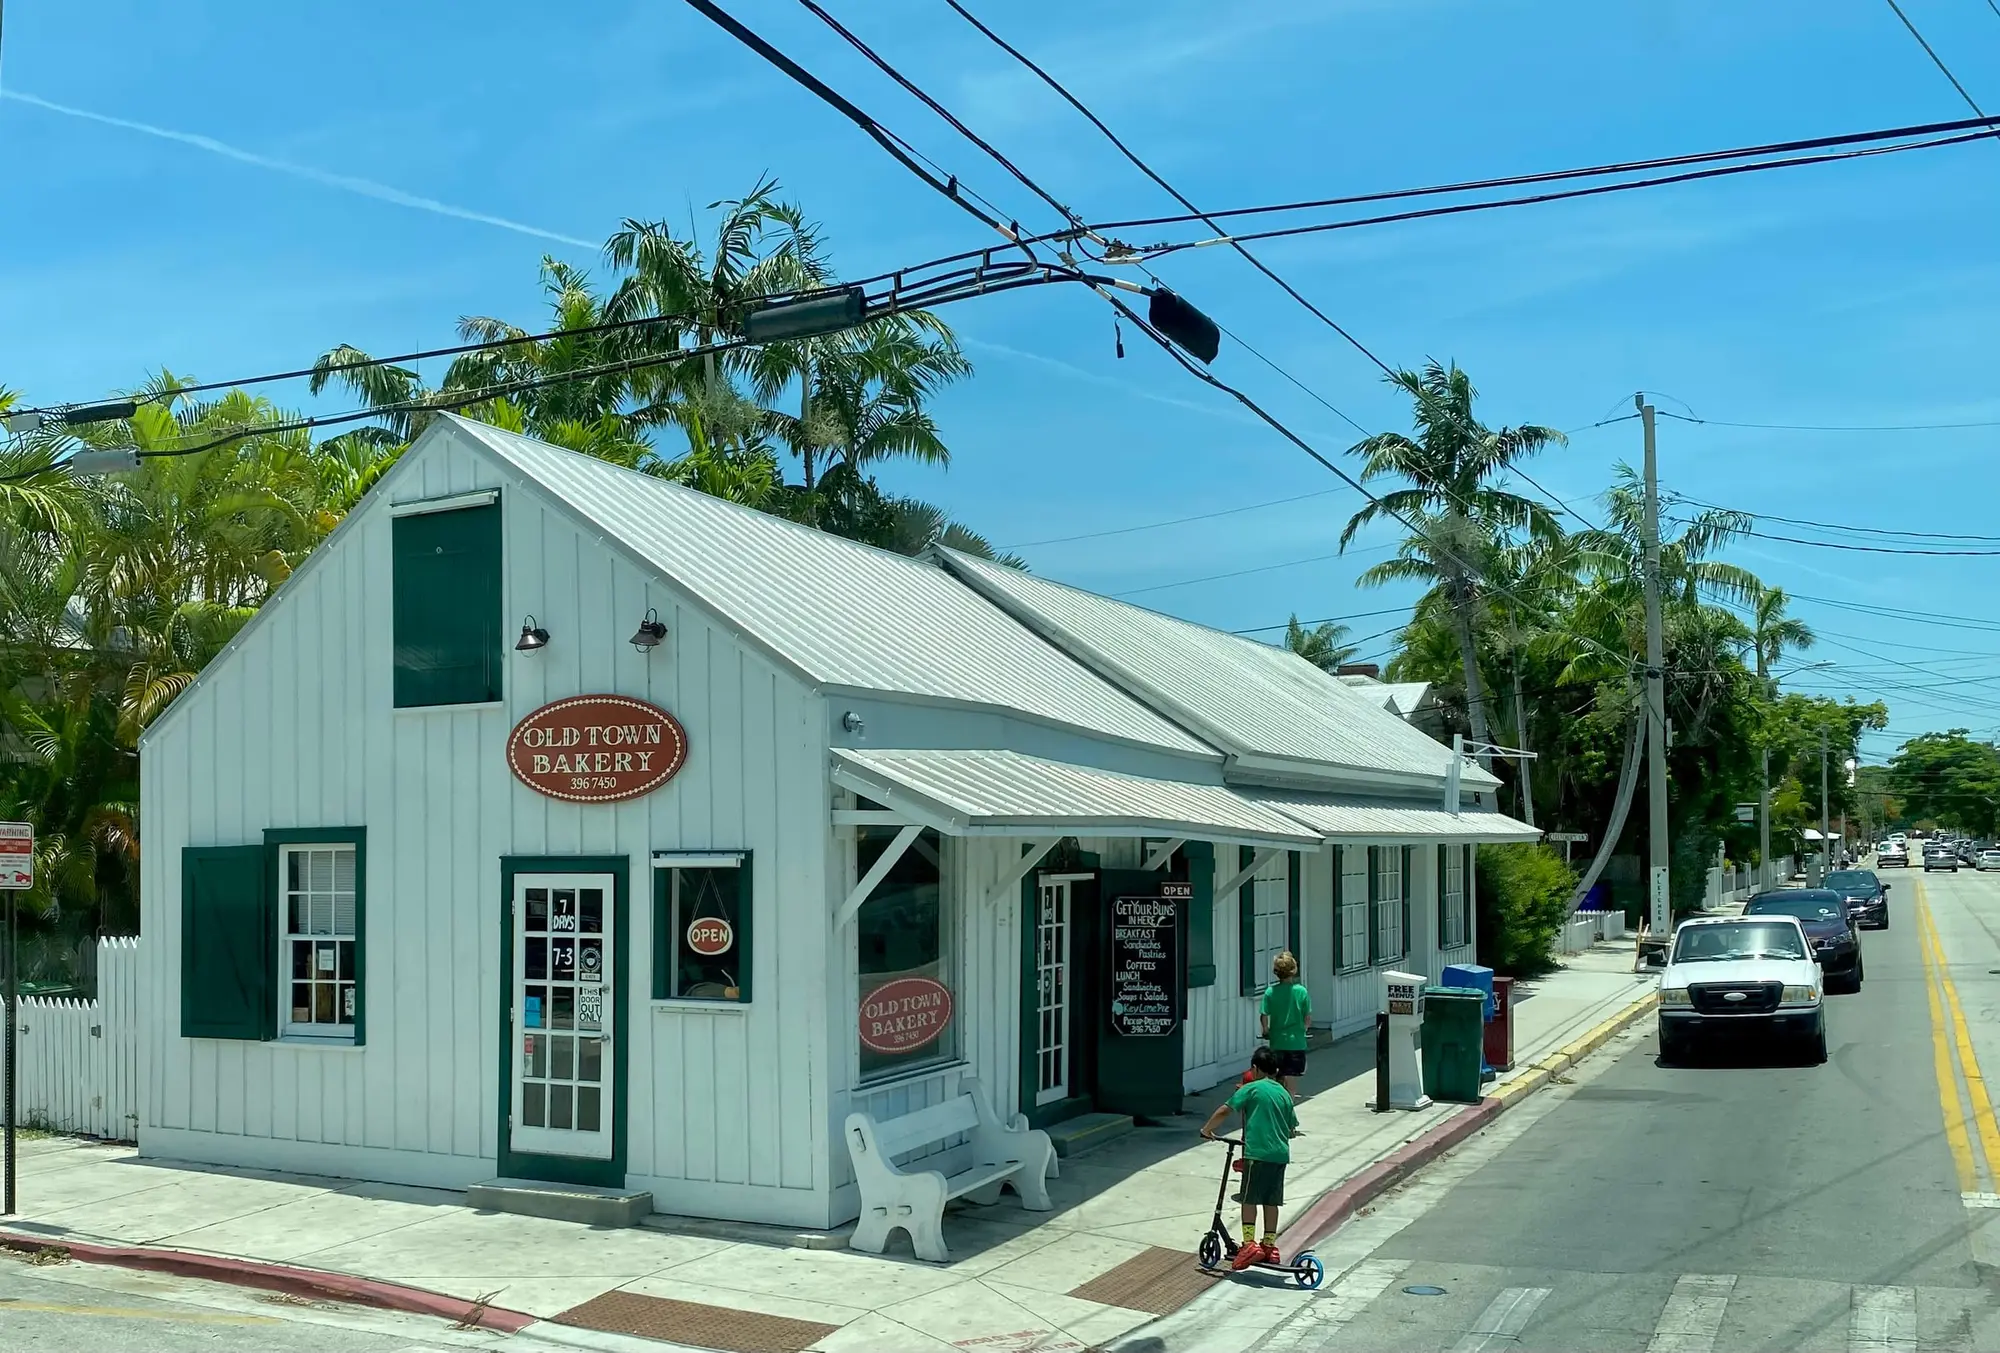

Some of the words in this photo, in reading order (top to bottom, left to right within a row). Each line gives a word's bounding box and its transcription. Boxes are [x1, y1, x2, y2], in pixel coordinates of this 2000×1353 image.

[523, 727, 580, 748] OLD
[584, 724, 662, 746] TOWN
[532, 751, 656, 774] BAKERY
[570, 777, 589, 790] 396
[592, 776, 617, 789] 7450
[1163, 886, 1190, 896] OPEN
[560, 899, 567, 914] 7
[1116, 900, 1132, 915] GET
[1131, 900, 1152, 915] YOUR
[1153, 900, 1175, 916] BUNS
[553, 915, 575, 930] DAYS
[1128, 916, 1136, 925] IN
[691, 928, 728, 943] OPEN
[1115, 929, 1156, 939] BREAKFAST
[553, 947, 573, 966] 7-3
[1116, 971, 1140, 981] LUNCH
[584, 988, 598, 996] THIS
[1388, 984, 1415, 993] FREE
[581, 1003, 600, 1014] OUT
[865, 1000, 898, 1019] OLD
[900, 991, 941, 1012] TOWN
[580, 1012, 602, 1022] ONLY
[871, 1009, 938, 1037] BAKERY
